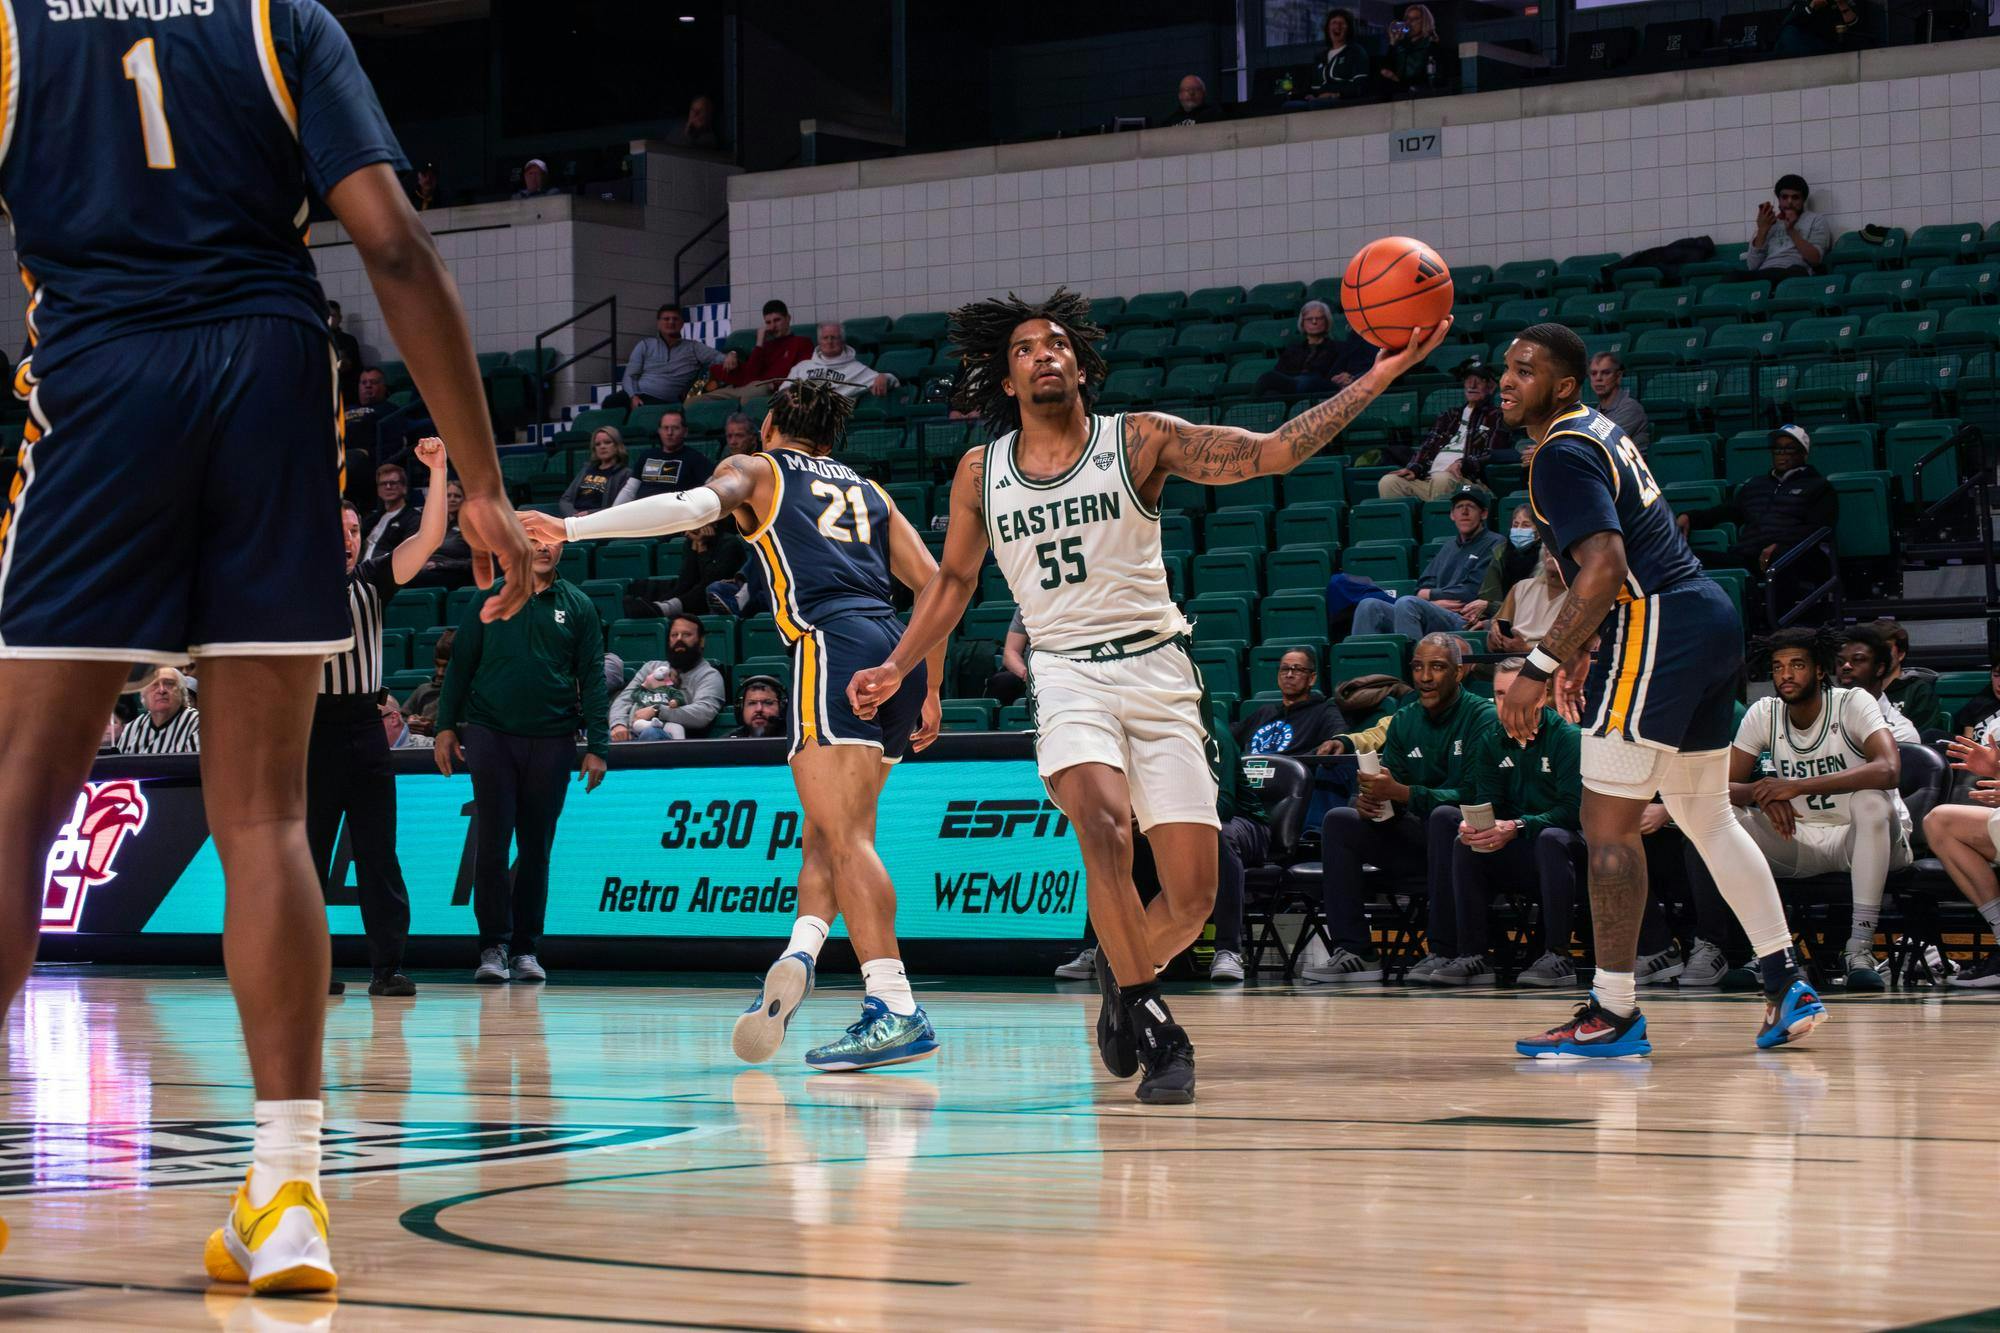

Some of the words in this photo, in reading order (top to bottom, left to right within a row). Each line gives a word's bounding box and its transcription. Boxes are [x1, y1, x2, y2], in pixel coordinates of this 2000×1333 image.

[47, 0, 215, 21] SIMMONS
[122, 37, 176, 169] 1
[1398, 135, 1435, 152] 107
[810, 479, 871, 545] 21
[996, 491, 1121, 543] EASTERN
[1035, 536, 1088, 590] 55
[1780, 753, 1848, 778] EASTERN
[661, 799, 758, 849] 3:30
[938, 799, 1071, 838] ESPN
[598, 876, 679, 913] Retro
[687, 876, 798, 913] Arcade
